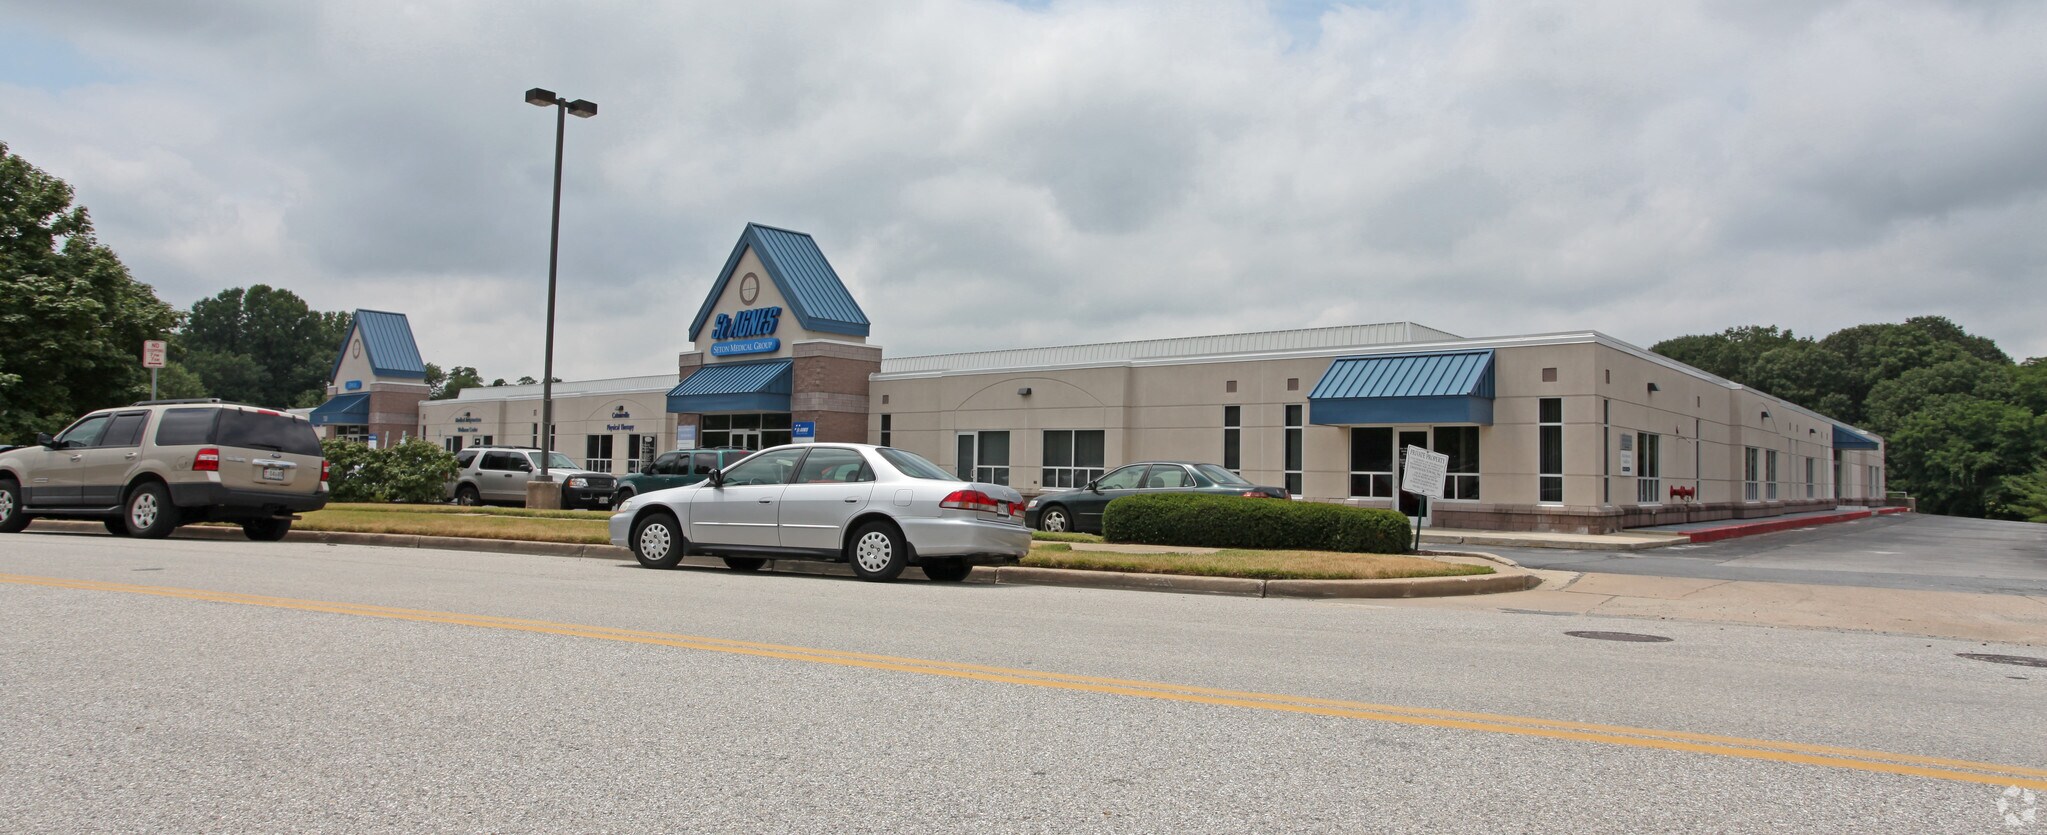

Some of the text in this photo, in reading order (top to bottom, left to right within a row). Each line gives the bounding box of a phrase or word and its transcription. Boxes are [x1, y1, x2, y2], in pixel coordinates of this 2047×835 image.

[728, 306, 782, 338] AGNES
[713, 341, 773, 354] SETON MEDICAL GROUP
[1410, 449, 1426, 459] PRIVATE
[1426, 454, 1445, 464] PROPERTY
